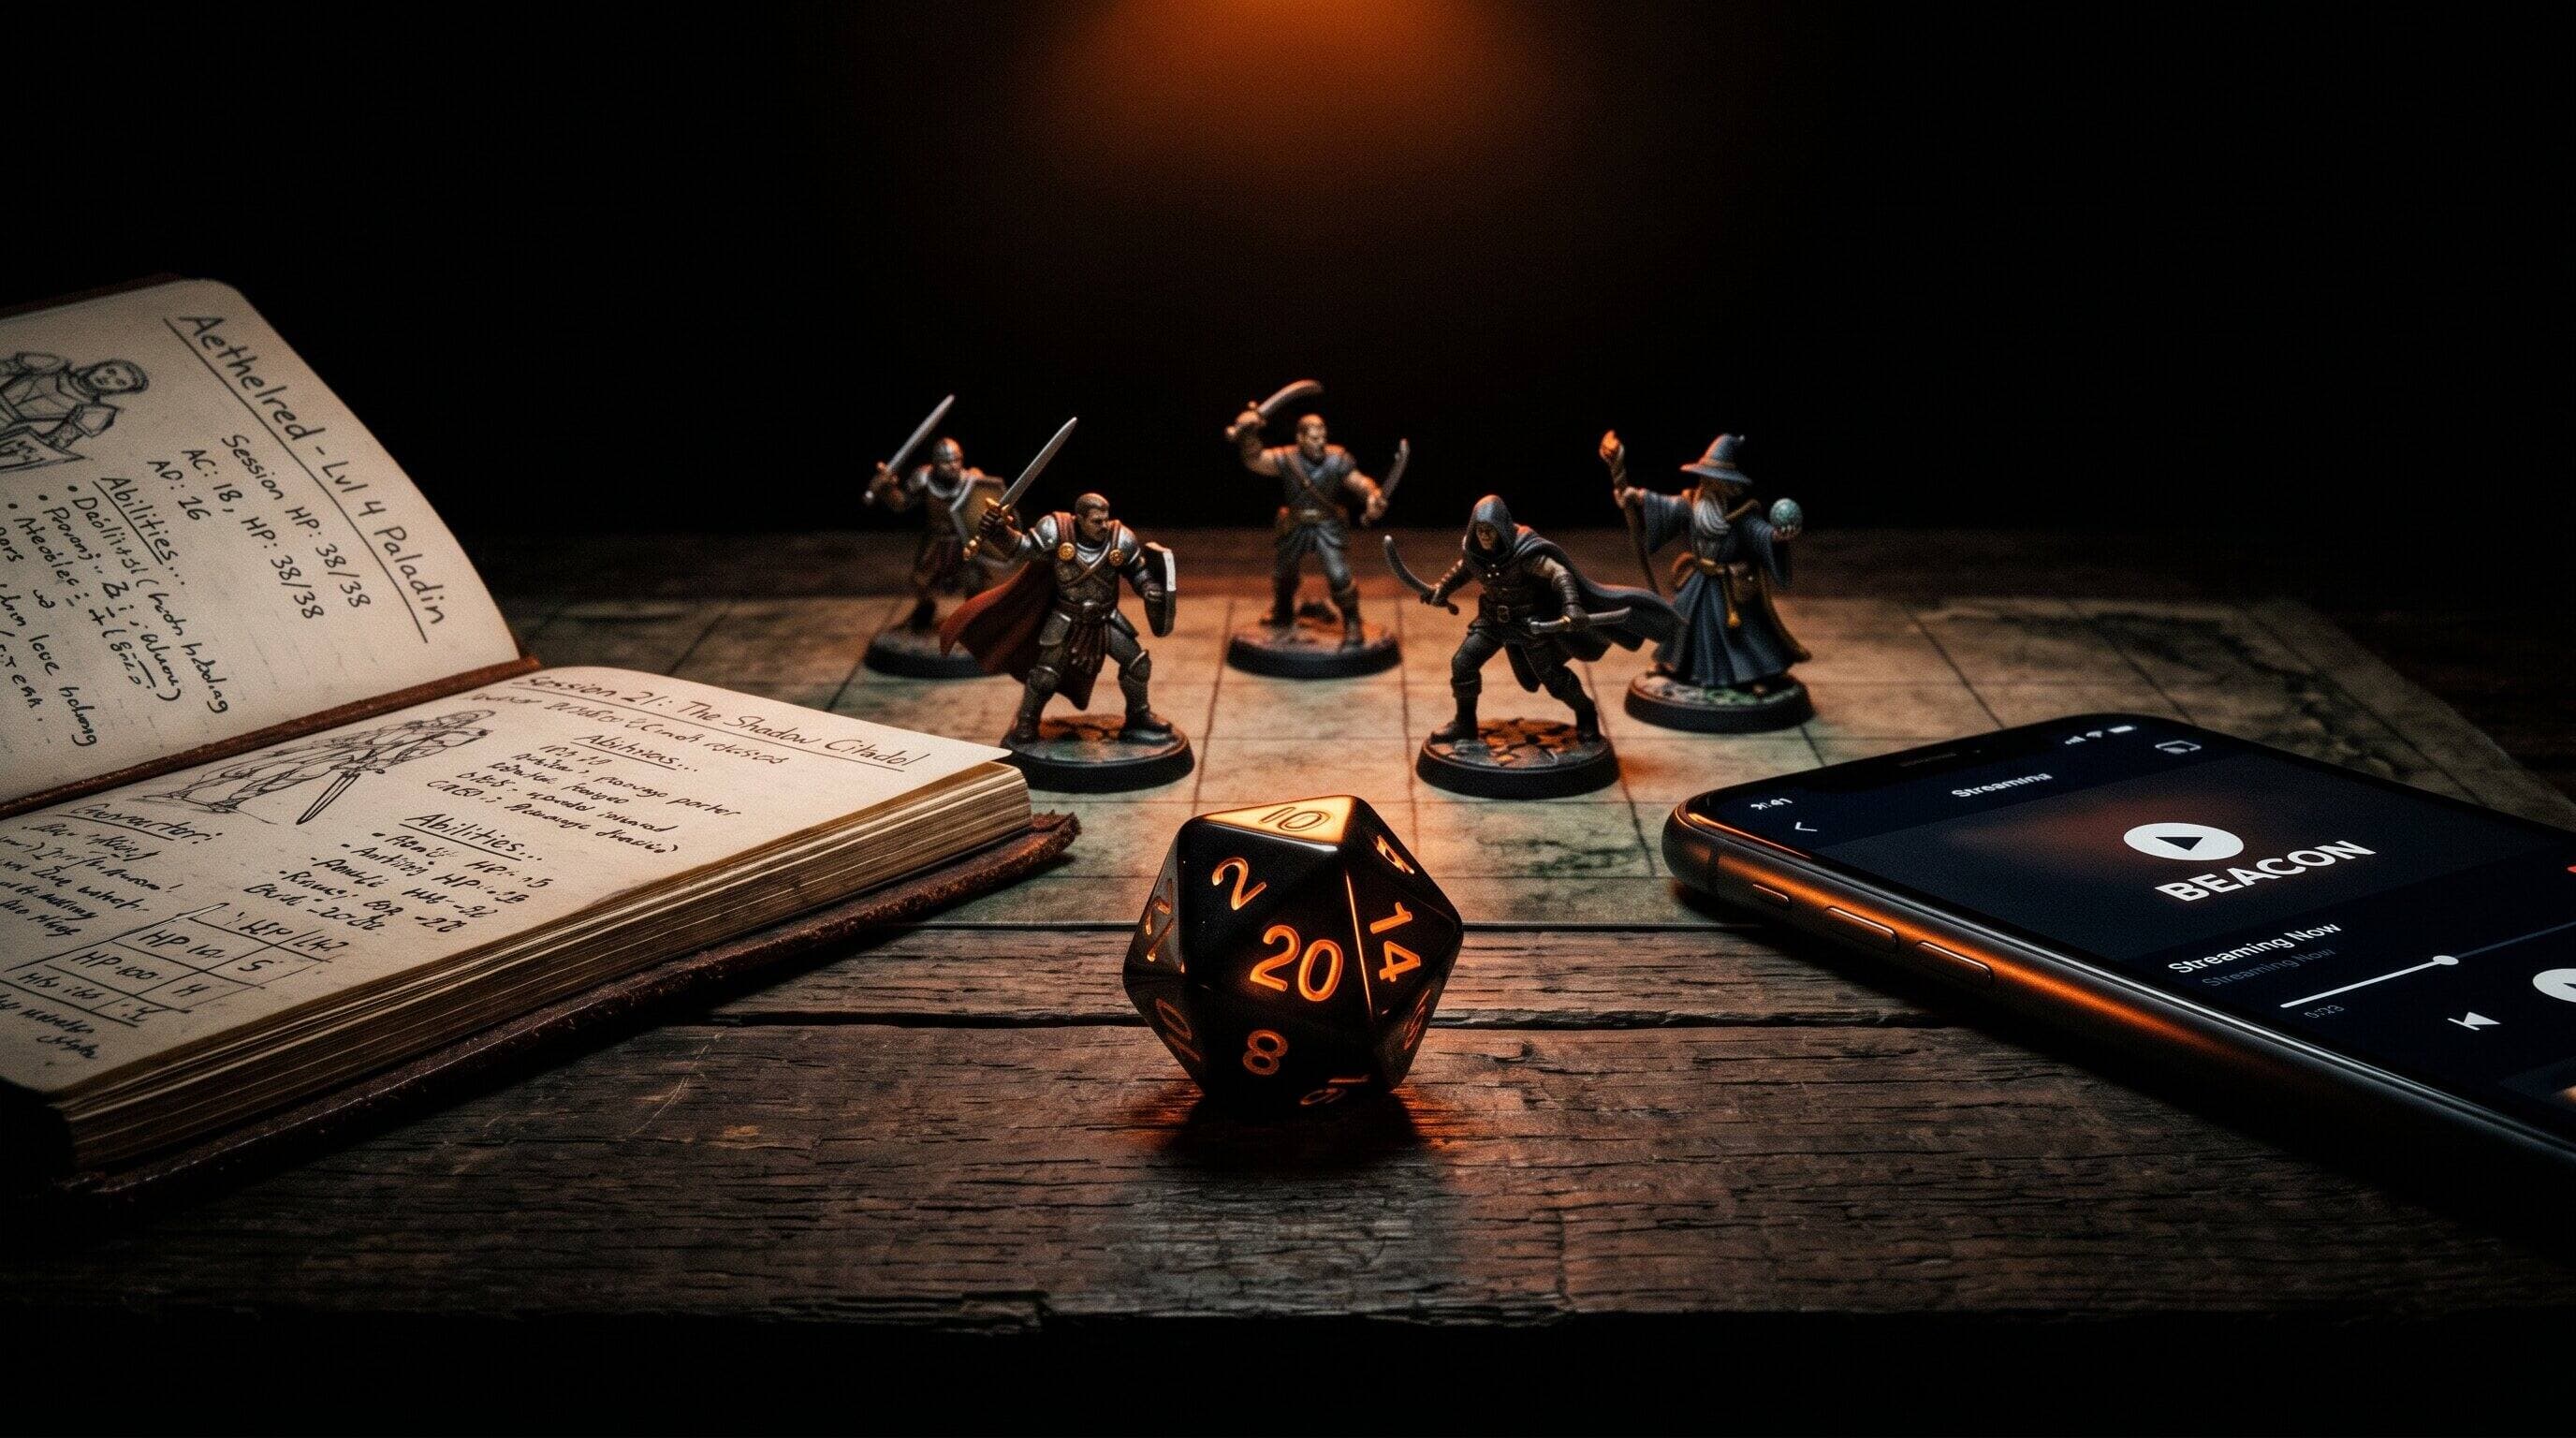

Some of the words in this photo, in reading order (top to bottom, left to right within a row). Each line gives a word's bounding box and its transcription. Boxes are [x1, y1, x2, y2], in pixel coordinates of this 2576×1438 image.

[179, 316, 326, 441] Aethelred
[321, 461, 368, 493] Lvl
[359, 501, 386, 517] 4
[374, 526, 446, 624] Paladin
[178, 496, 212, 521] 16
[182, 449, 218, 477] AC:
[242, 517, 278, 549] HP:
[271, 555, 324, 620] 38/38
[221, 434, 285, 500] Session
[285, 506, 322, 537] HP:
[315, 543, 372, 608] 38/38
[677, 700, 721, 721] The
[722, 715, 822, 746] Shadow
[1951, 771, 2054, 800] Streaming
[1258, 806, 1332, 832] 10
[1211, 857, 1267, 911] 2
[2154, 840, 2377, 902] BEACON
[1250, 924, 1344, 1003] 20
[1369, 902, 1421, 983] 14
[2167, 934, 2297, 975] Streaming
[2284, 923, 2343, 943] Now
[2202, 955, 2302, 988] Streaming
[2291, 948, 2336, 962] Now
[1242, 1029, 1289, 1076] 8
